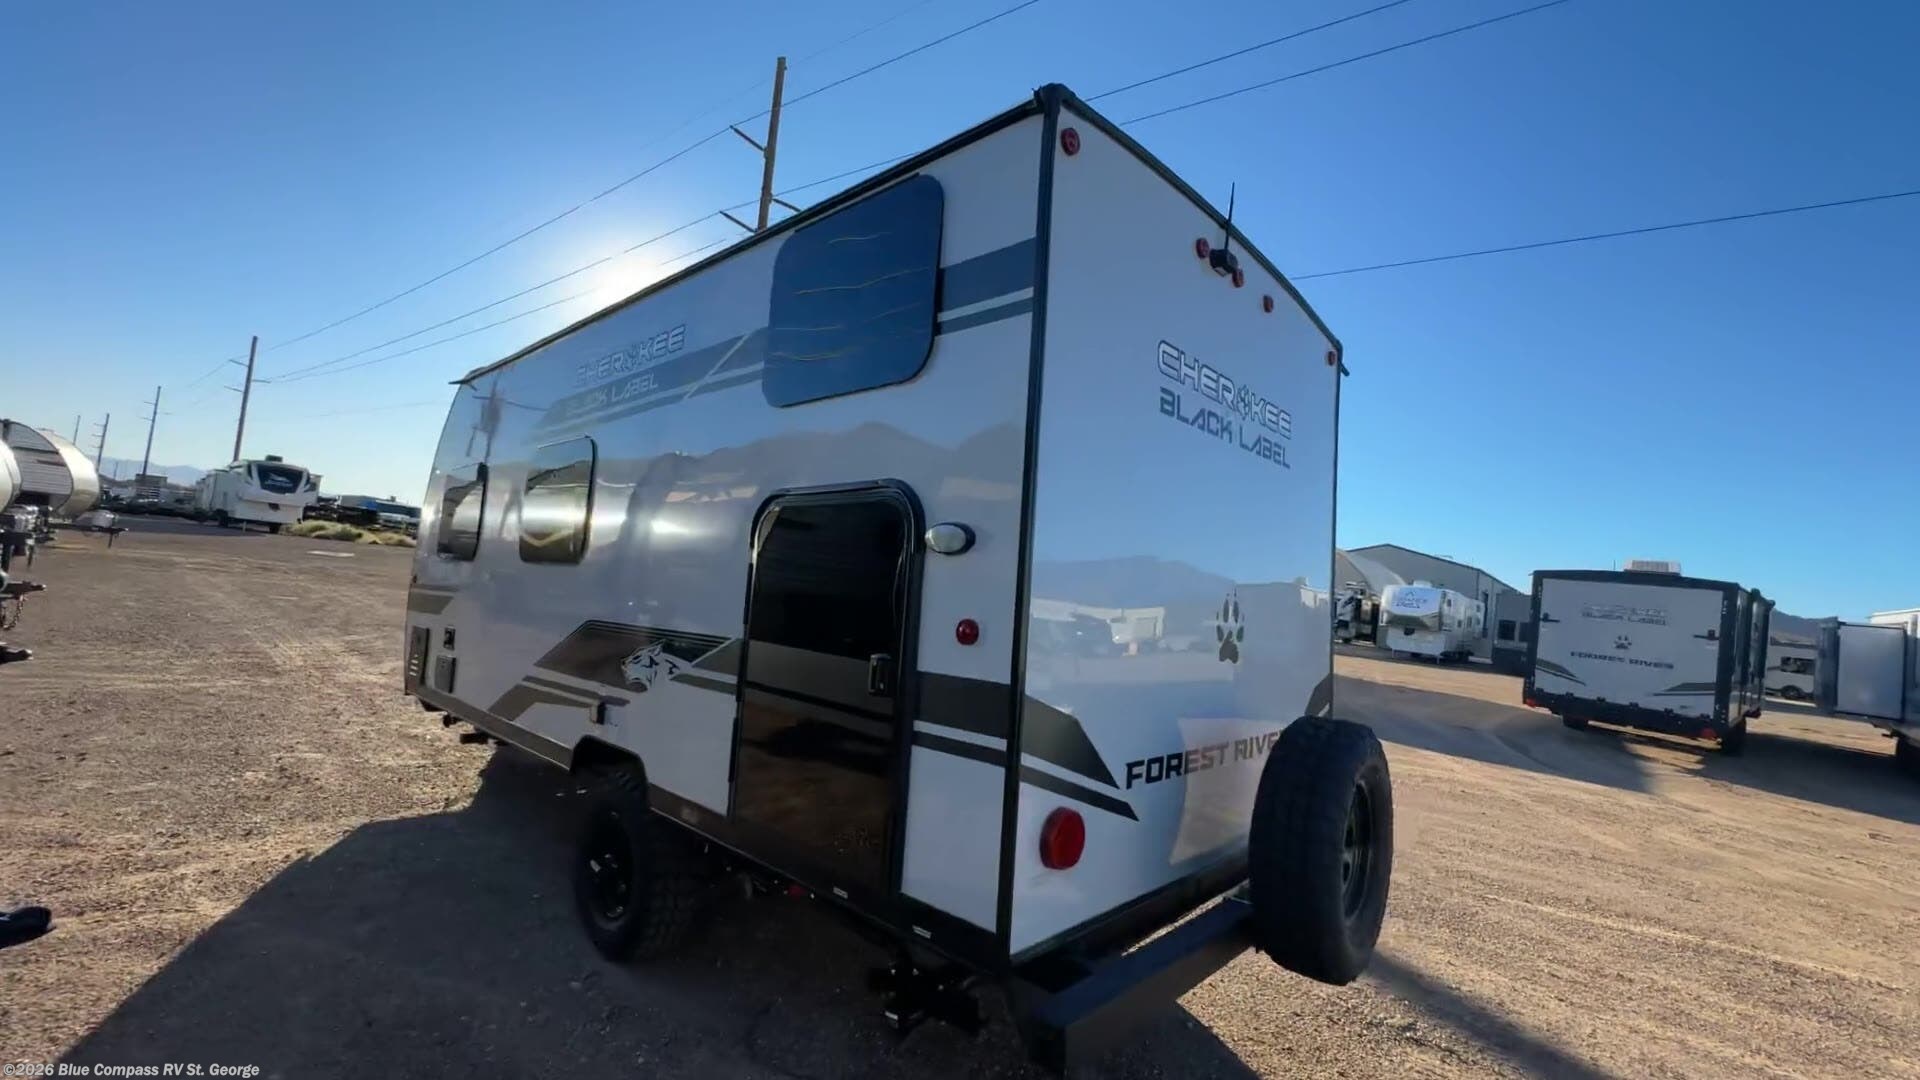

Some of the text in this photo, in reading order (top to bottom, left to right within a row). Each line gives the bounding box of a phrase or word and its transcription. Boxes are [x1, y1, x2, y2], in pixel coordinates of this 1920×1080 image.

[1158, 340, 1292, 440] CHEROKEE
[1160, 386, 1290, 469] BLACK LABEL
[1125, 730, 1281, 790] FOREST RIVE
